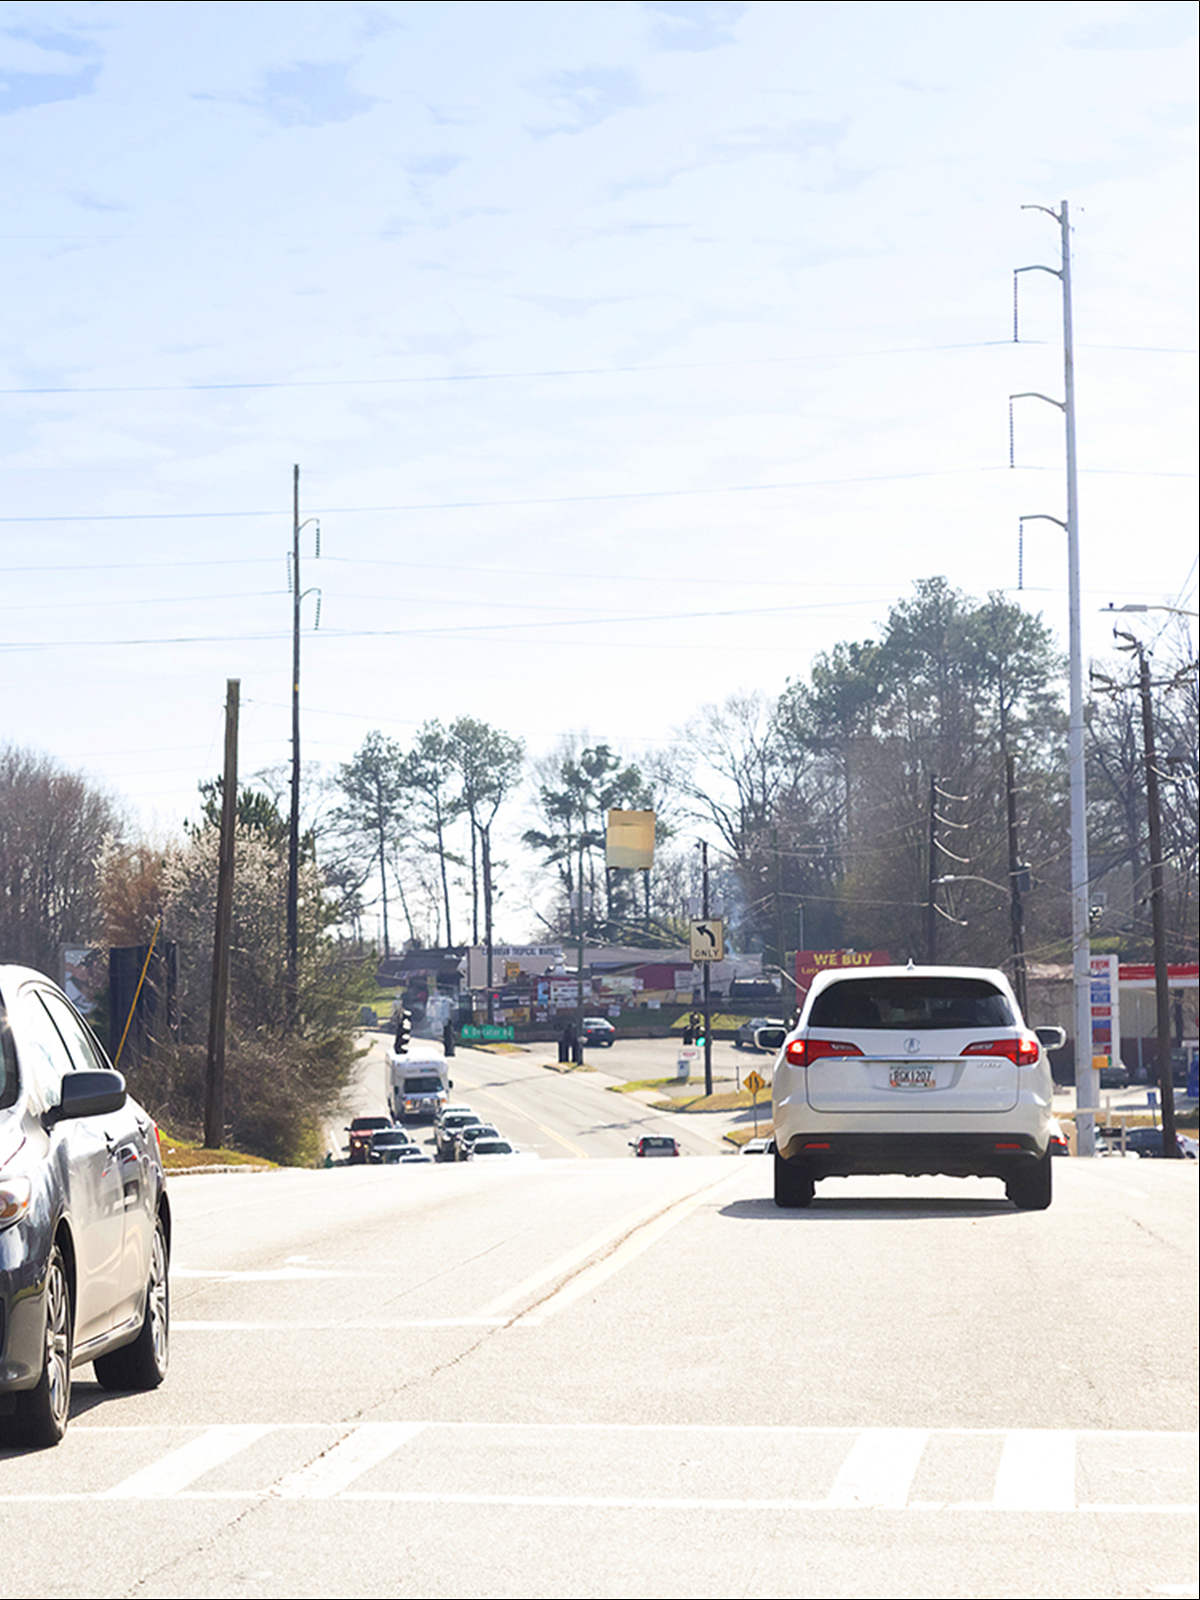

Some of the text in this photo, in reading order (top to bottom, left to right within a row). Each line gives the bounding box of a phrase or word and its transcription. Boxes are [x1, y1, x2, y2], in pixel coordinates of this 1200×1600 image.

[694, 949, 720, 957] ONLY
[813, 953, 872, 965] WE BUY
